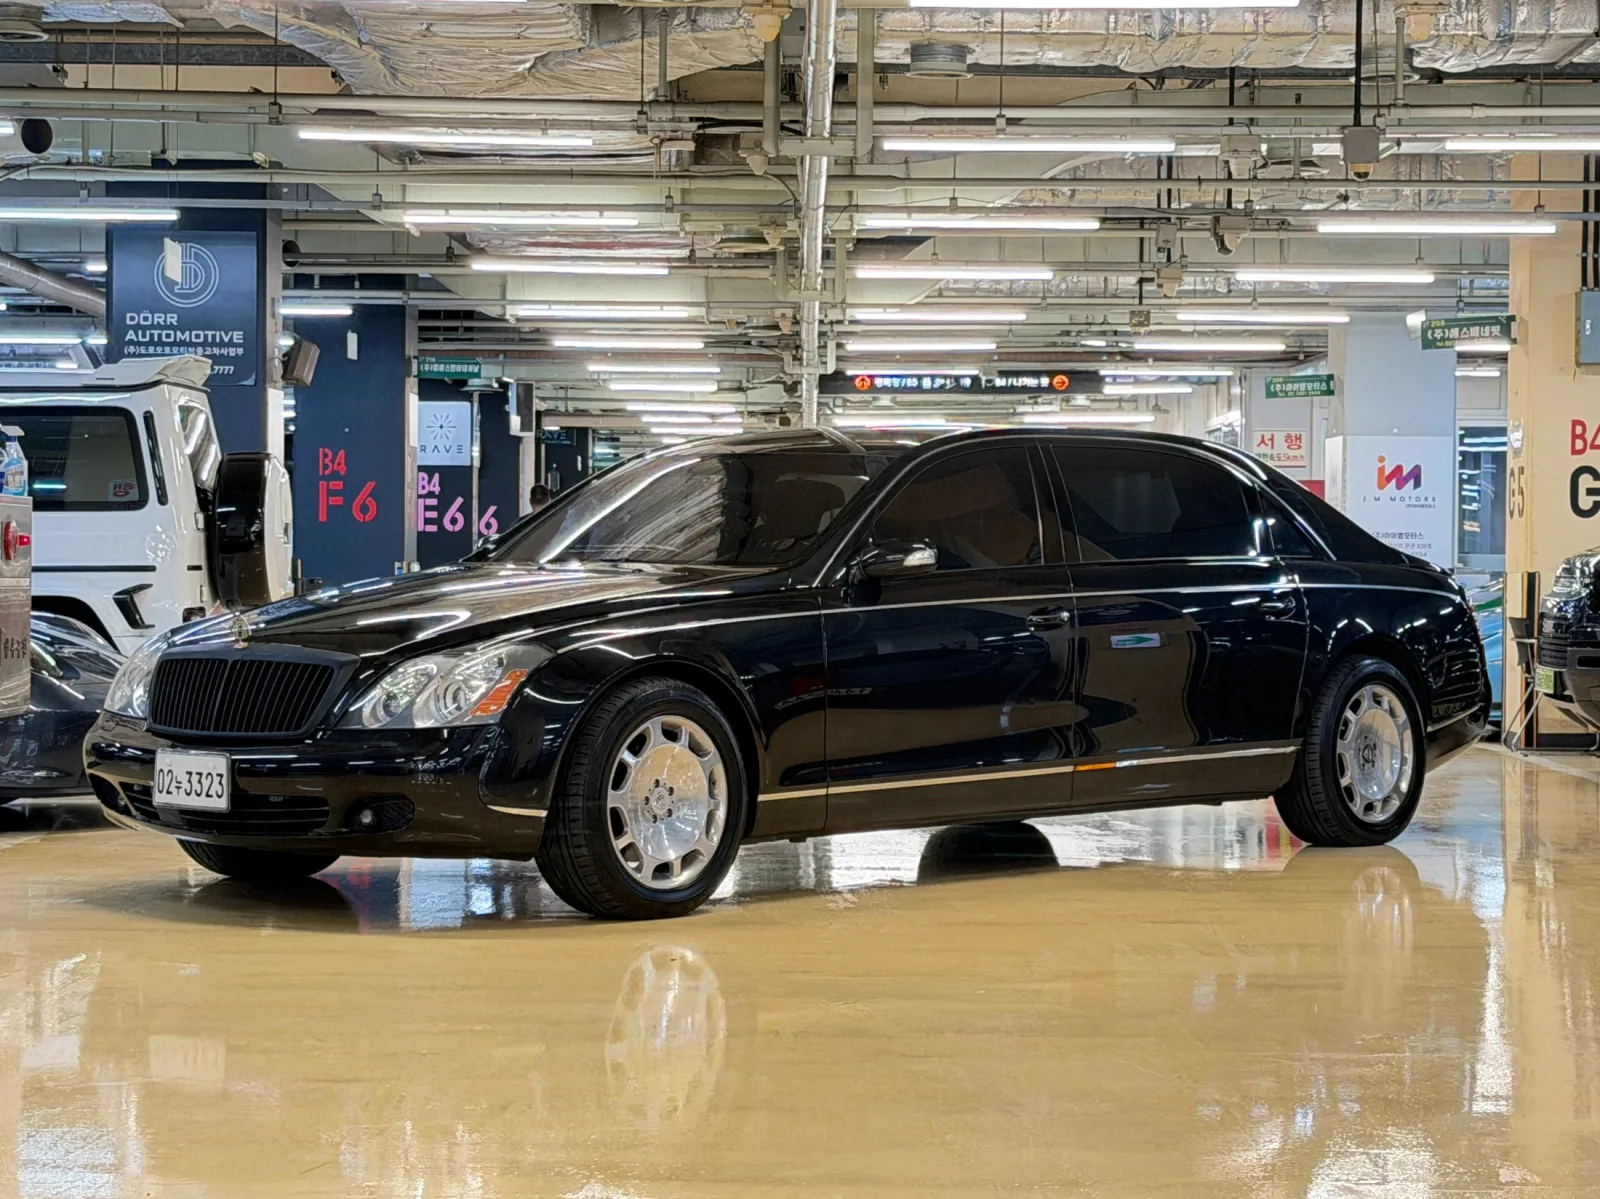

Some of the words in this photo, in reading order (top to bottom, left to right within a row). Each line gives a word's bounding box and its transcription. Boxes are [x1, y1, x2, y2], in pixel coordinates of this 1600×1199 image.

[126, 310, 178, 326] DÖRR
[125, 330, 244, 343] AUTOMOTIVE
[420, 444, 464, 454] RAVE
[319, 447, 347, 476] B4
[418, 472, 440, 495] B4
[1508, 466, 1525, 520] G5
[157, 768, 225, 799] 02누3323
